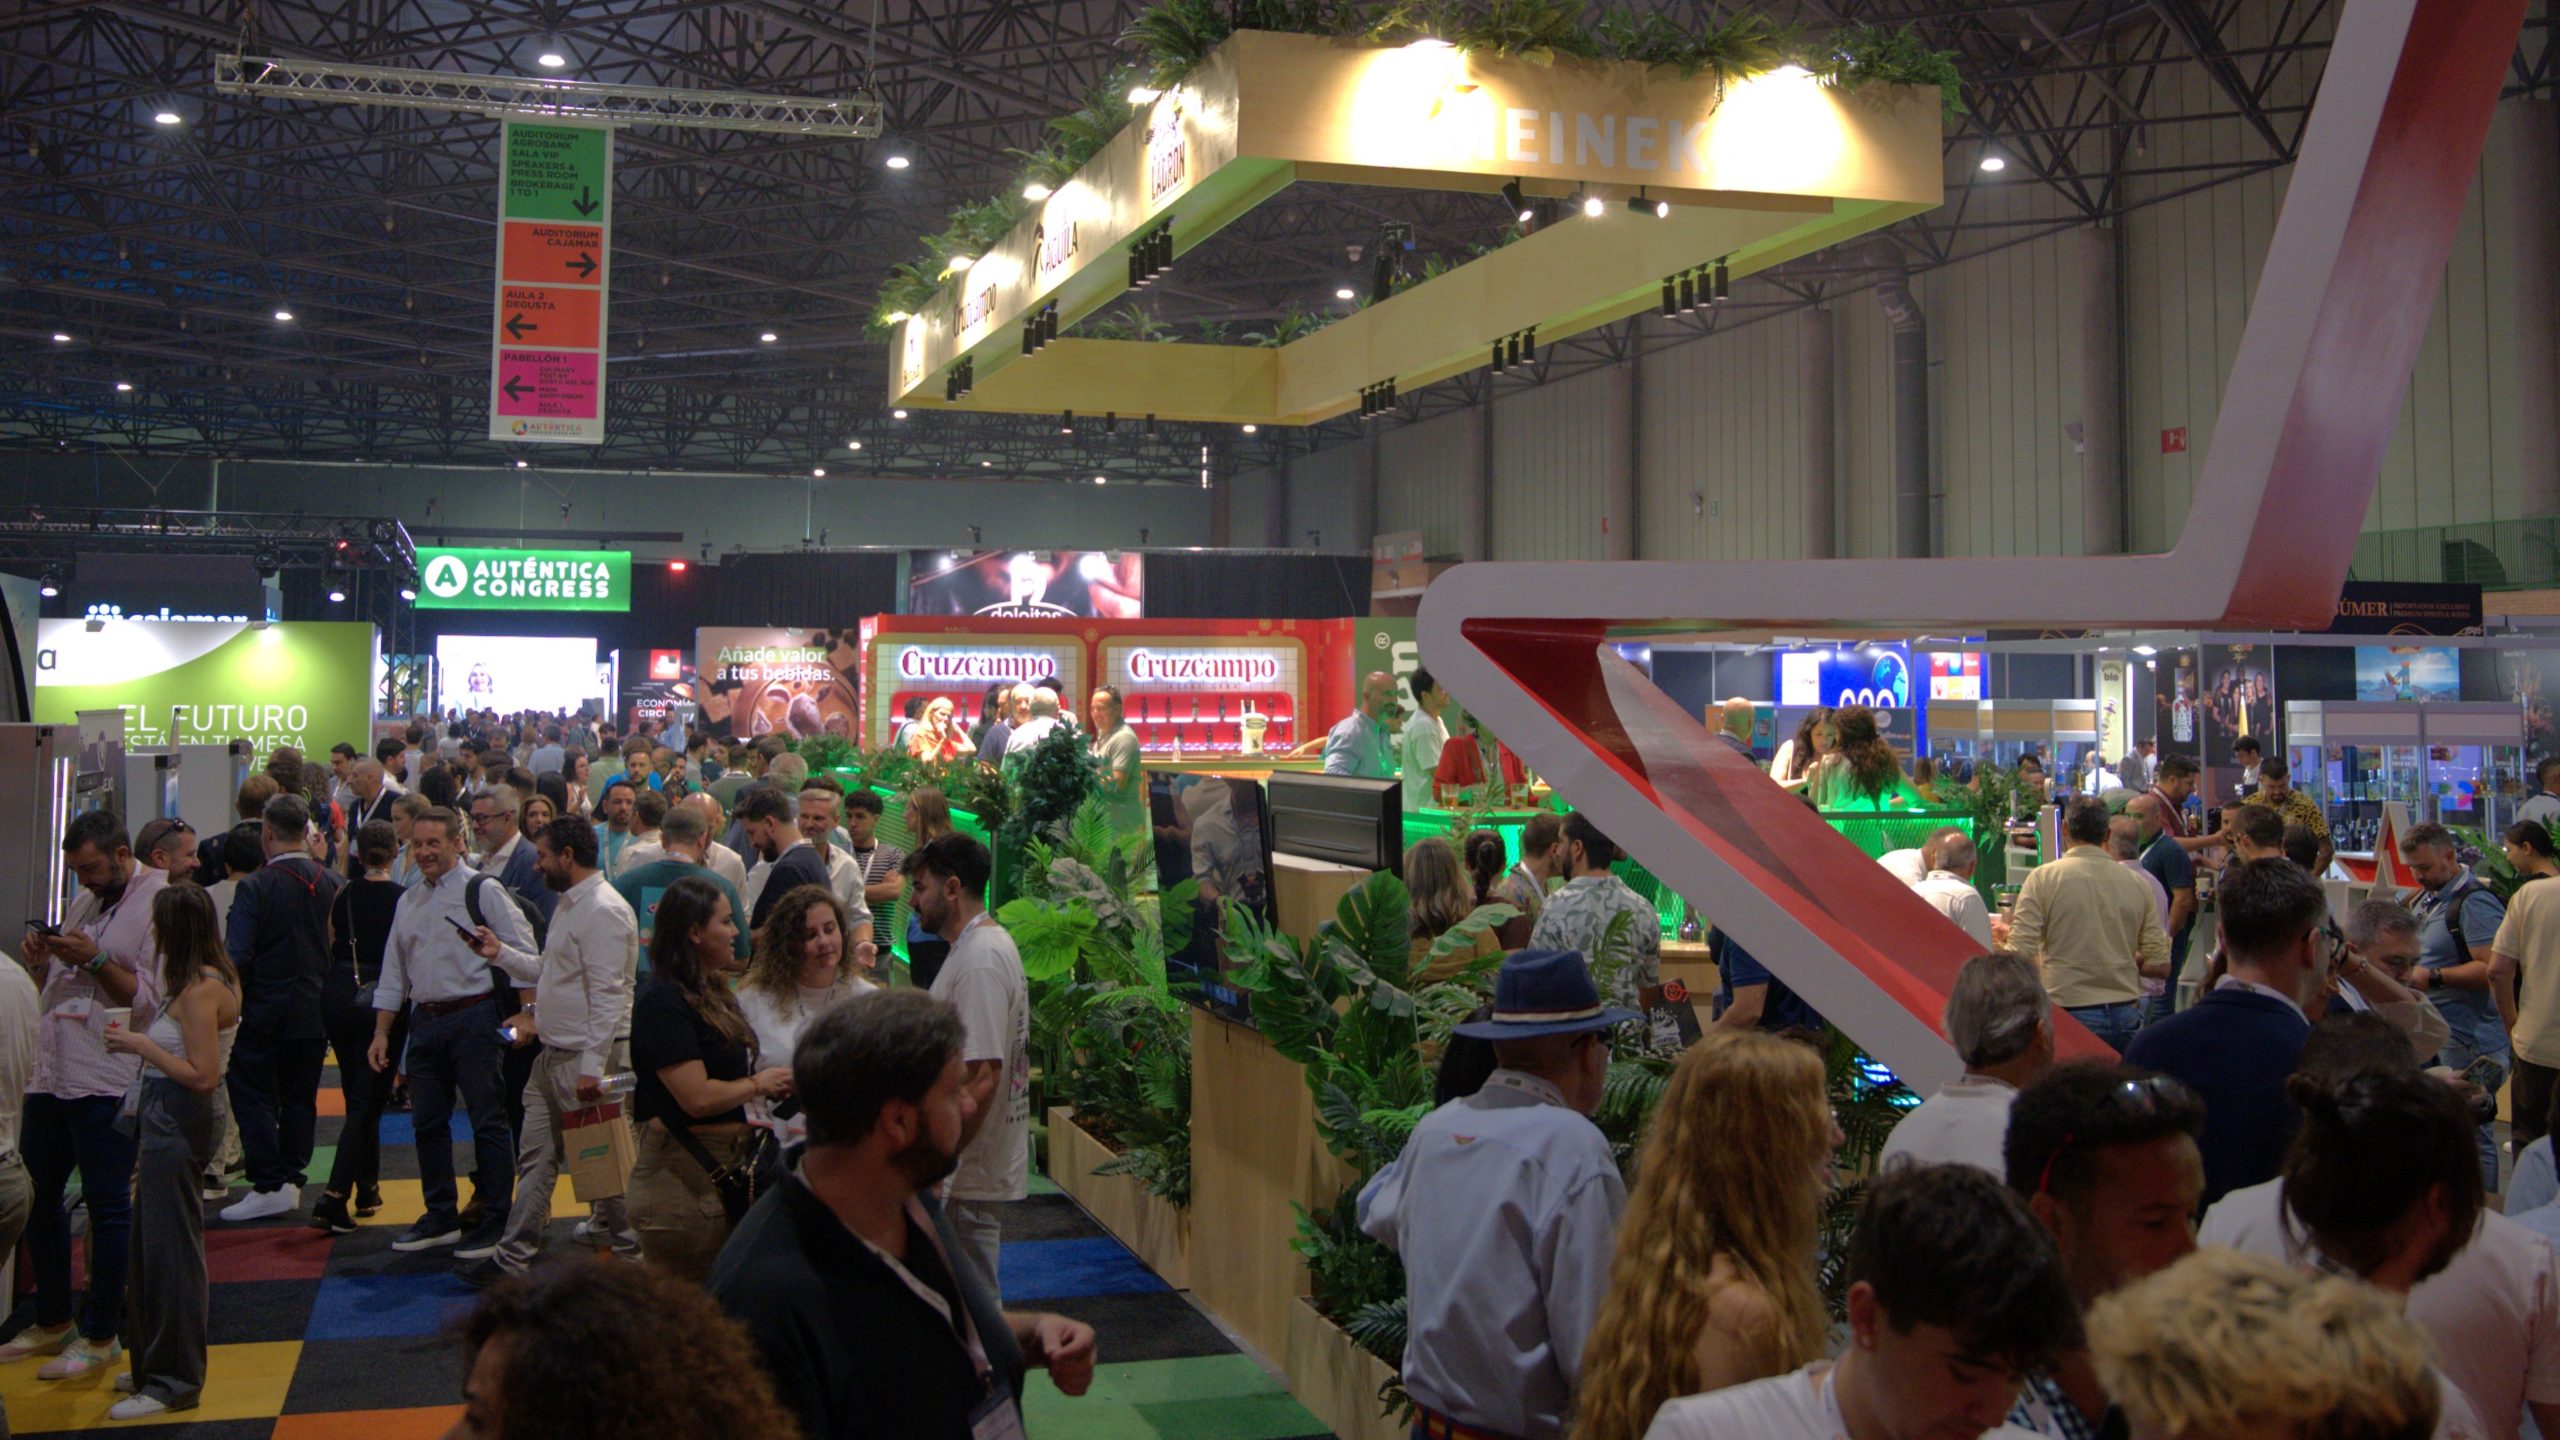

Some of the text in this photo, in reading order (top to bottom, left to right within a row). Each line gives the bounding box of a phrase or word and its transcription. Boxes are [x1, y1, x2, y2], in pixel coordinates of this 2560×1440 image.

[512, 130, 579, 140] AUDITORIUM
[511, 139, 572, 149] AGROBANK
[511, 149, 560, 159] SALA VIP
[511, 160, 575, 171] SPEAKERS &
[510, 169, 578, 180] PRESS ROOM
[510, 179, 576, 191] BROKERAGE
[510, 188, 515, 196] 1
[517, 189, 532, 197] TO
[532, 228, 599, 239] AUDITORIUM
[547, 238, 599, 248] CAJAMAR
[506, 290, 545, 300] AULA 2
[506, 300, 556, 310] DEGUSTA
[504, 353, 568, 363] PABELLÓN 1
[473, 556, 611, 580] AUTÉNTICA
[472, 579, 610, 598] CONGRESS
[718, 646, 826, 663] Añade valor
[901, 648, 1056, 683] Cruzcampo
[1129, 651, 1278, 683] Cruzcampo
[717, 664, 836, 681] a tus bebidas.
[117, 704, 308, 732] EL FUTURO
[248, 735, 307, 752] MESA
